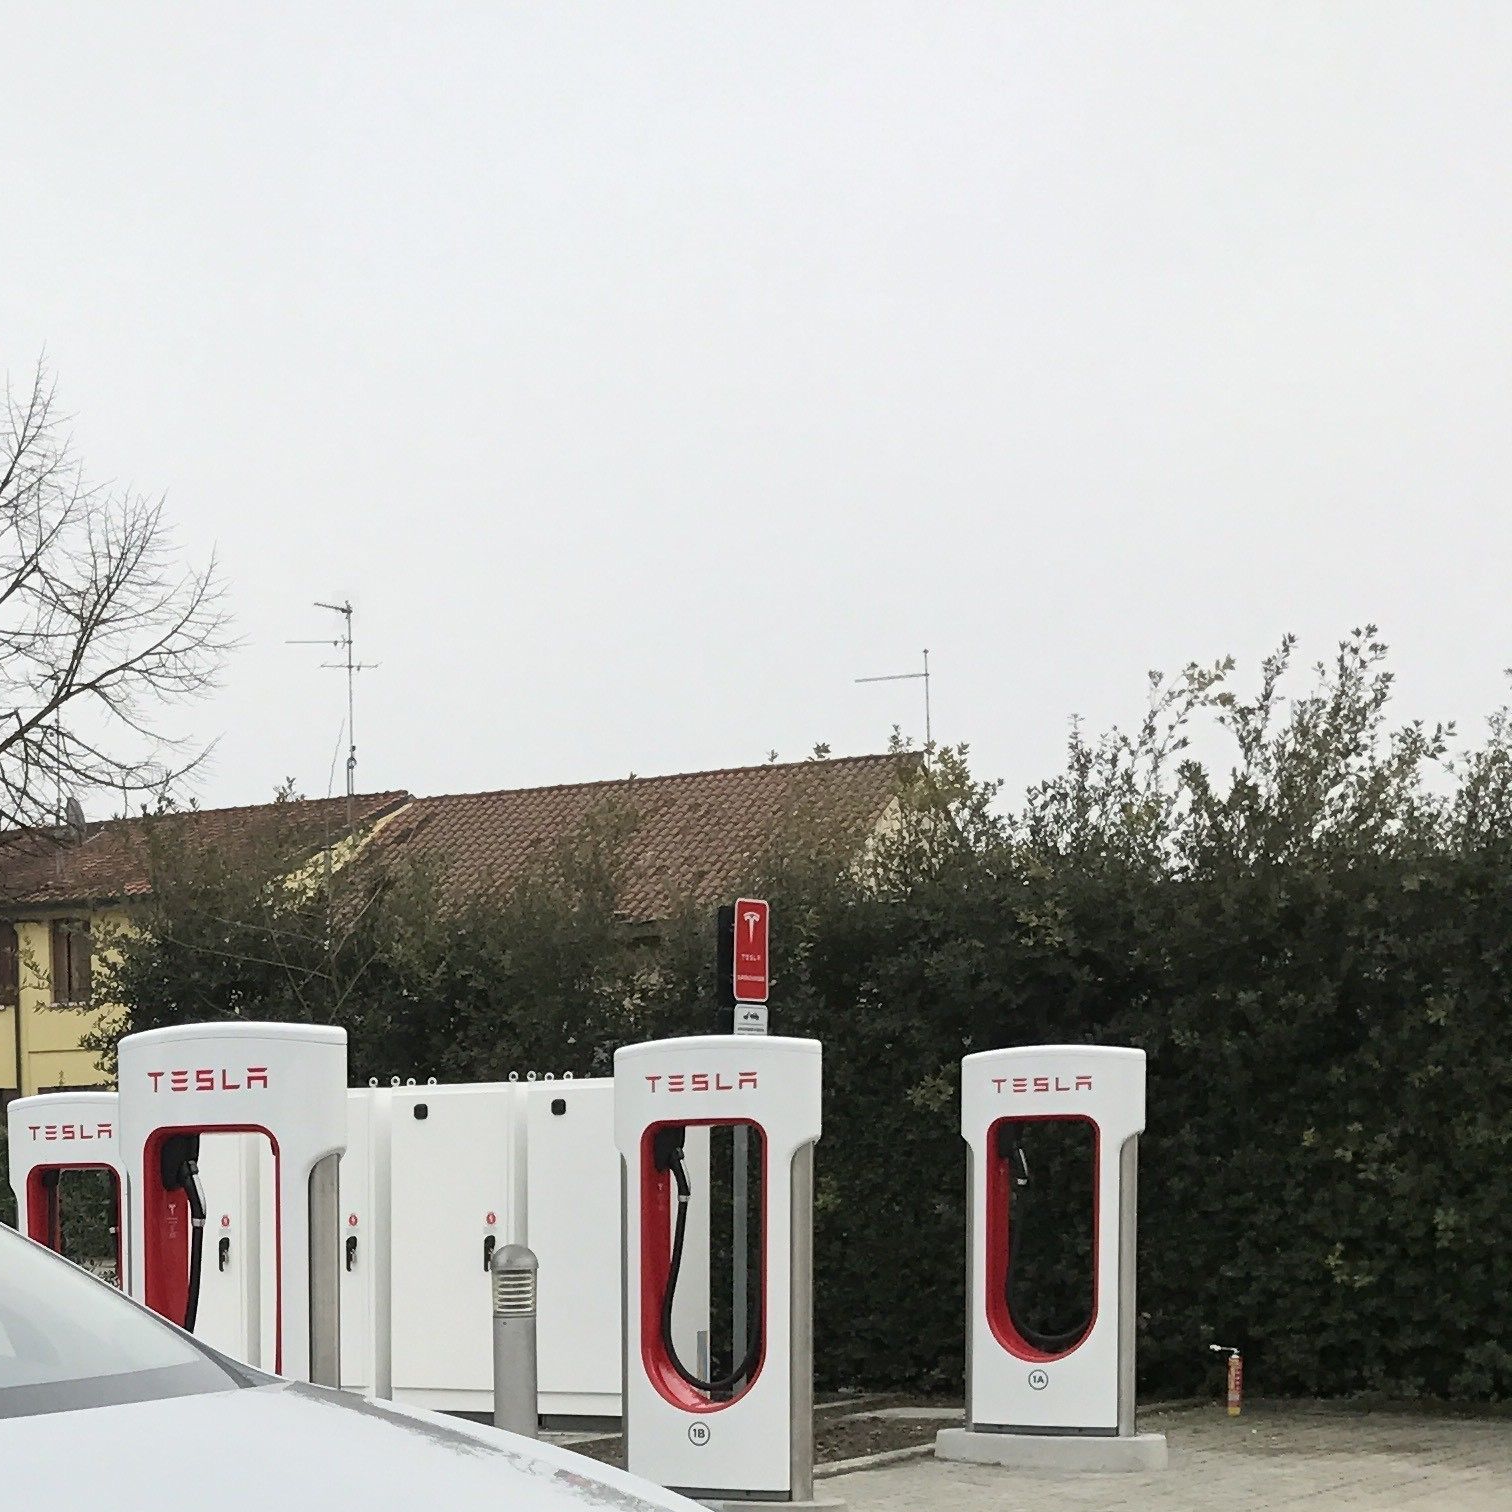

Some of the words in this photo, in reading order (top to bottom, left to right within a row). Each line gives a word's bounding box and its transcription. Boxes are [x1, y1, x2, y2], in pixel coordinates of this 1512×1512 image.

[146, 1066, 269, 1093] TESLA
[645, 1071, 758, 1093] TESLA
[991, 1075, 1092, 1094] TESLA
[28, 1123, 113, 1141] TESLA
[1033, 1375, 1044, 1384] 1A
[693, 1428, 705, 1439] 1B
